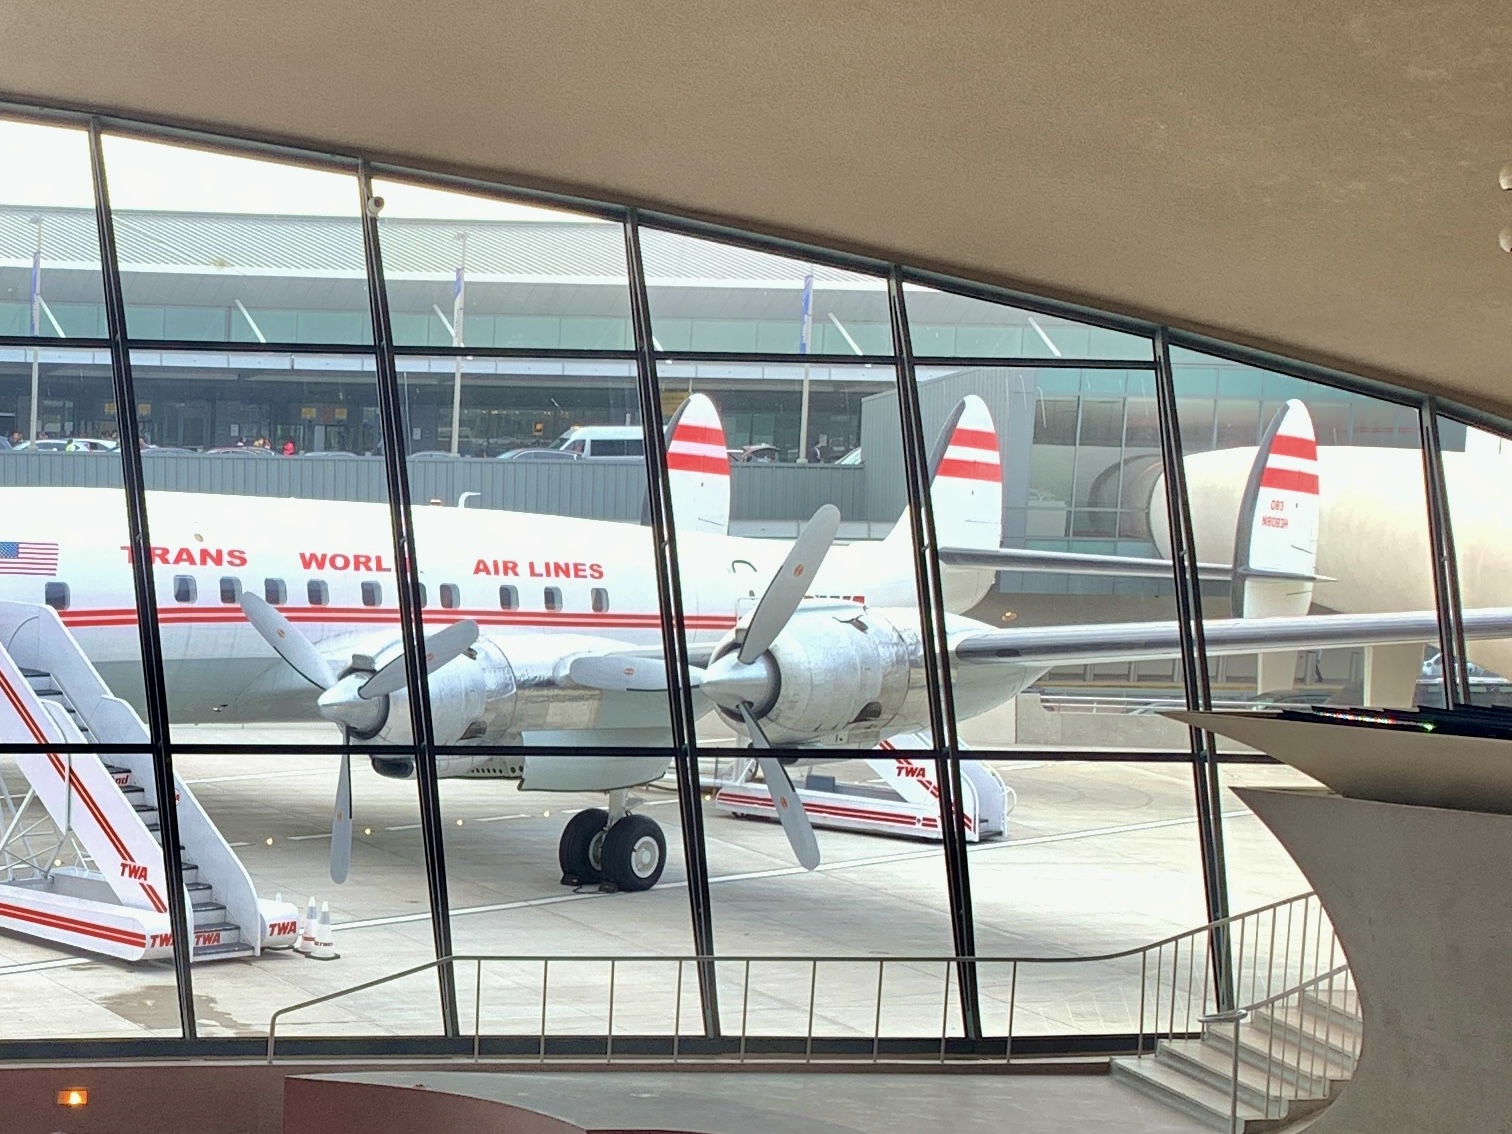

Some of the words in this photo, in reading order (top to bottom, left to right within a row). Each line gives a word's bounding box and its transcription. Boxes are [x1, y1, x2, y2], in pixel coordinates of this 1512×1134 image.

[298, 552, 408, 573] WORL
[472, 559, 520, 577] AIR
[528, 561, 604, 579] LINES
[896, 766, 926, 778] TWA
[120, 862, 148, 881] TWA
[269, 921, 297, 936] TWA
[150, 933, 174, 948] TW
[194, 932, 221, 945] TWA
